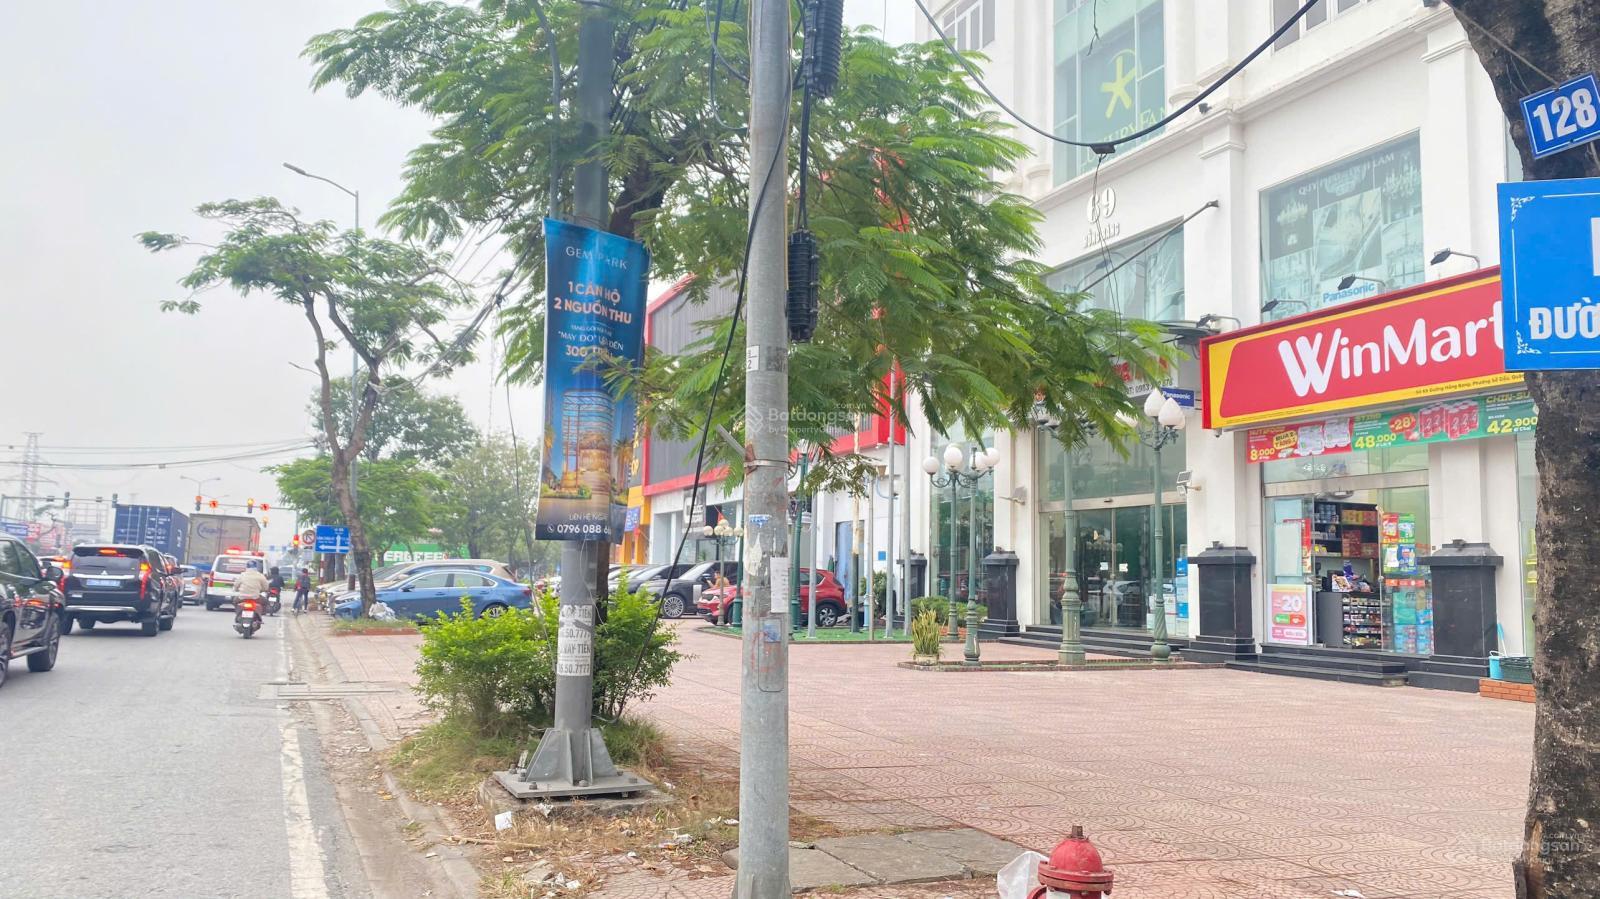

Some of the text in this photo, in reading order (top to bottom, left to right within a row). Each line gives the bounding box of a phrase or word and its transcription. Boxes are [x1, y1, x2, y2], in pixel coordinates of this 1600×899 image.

[1533, 88, 1598, 142] 128
[568, 281, 574, 294] 1
[1323, 282, 1375, 302] Panasonic
[553, 297, 563, 310] 2
[608, 308, 632, 325] THU
[1278, 301, 1503, 397] WinMart
[1487, 416, 1538, 434] 42.900
[1355, 433, 1397, 448] 48.000
[556, 524, 580, 534] 0796
[582, 524, 602, 534] 088
